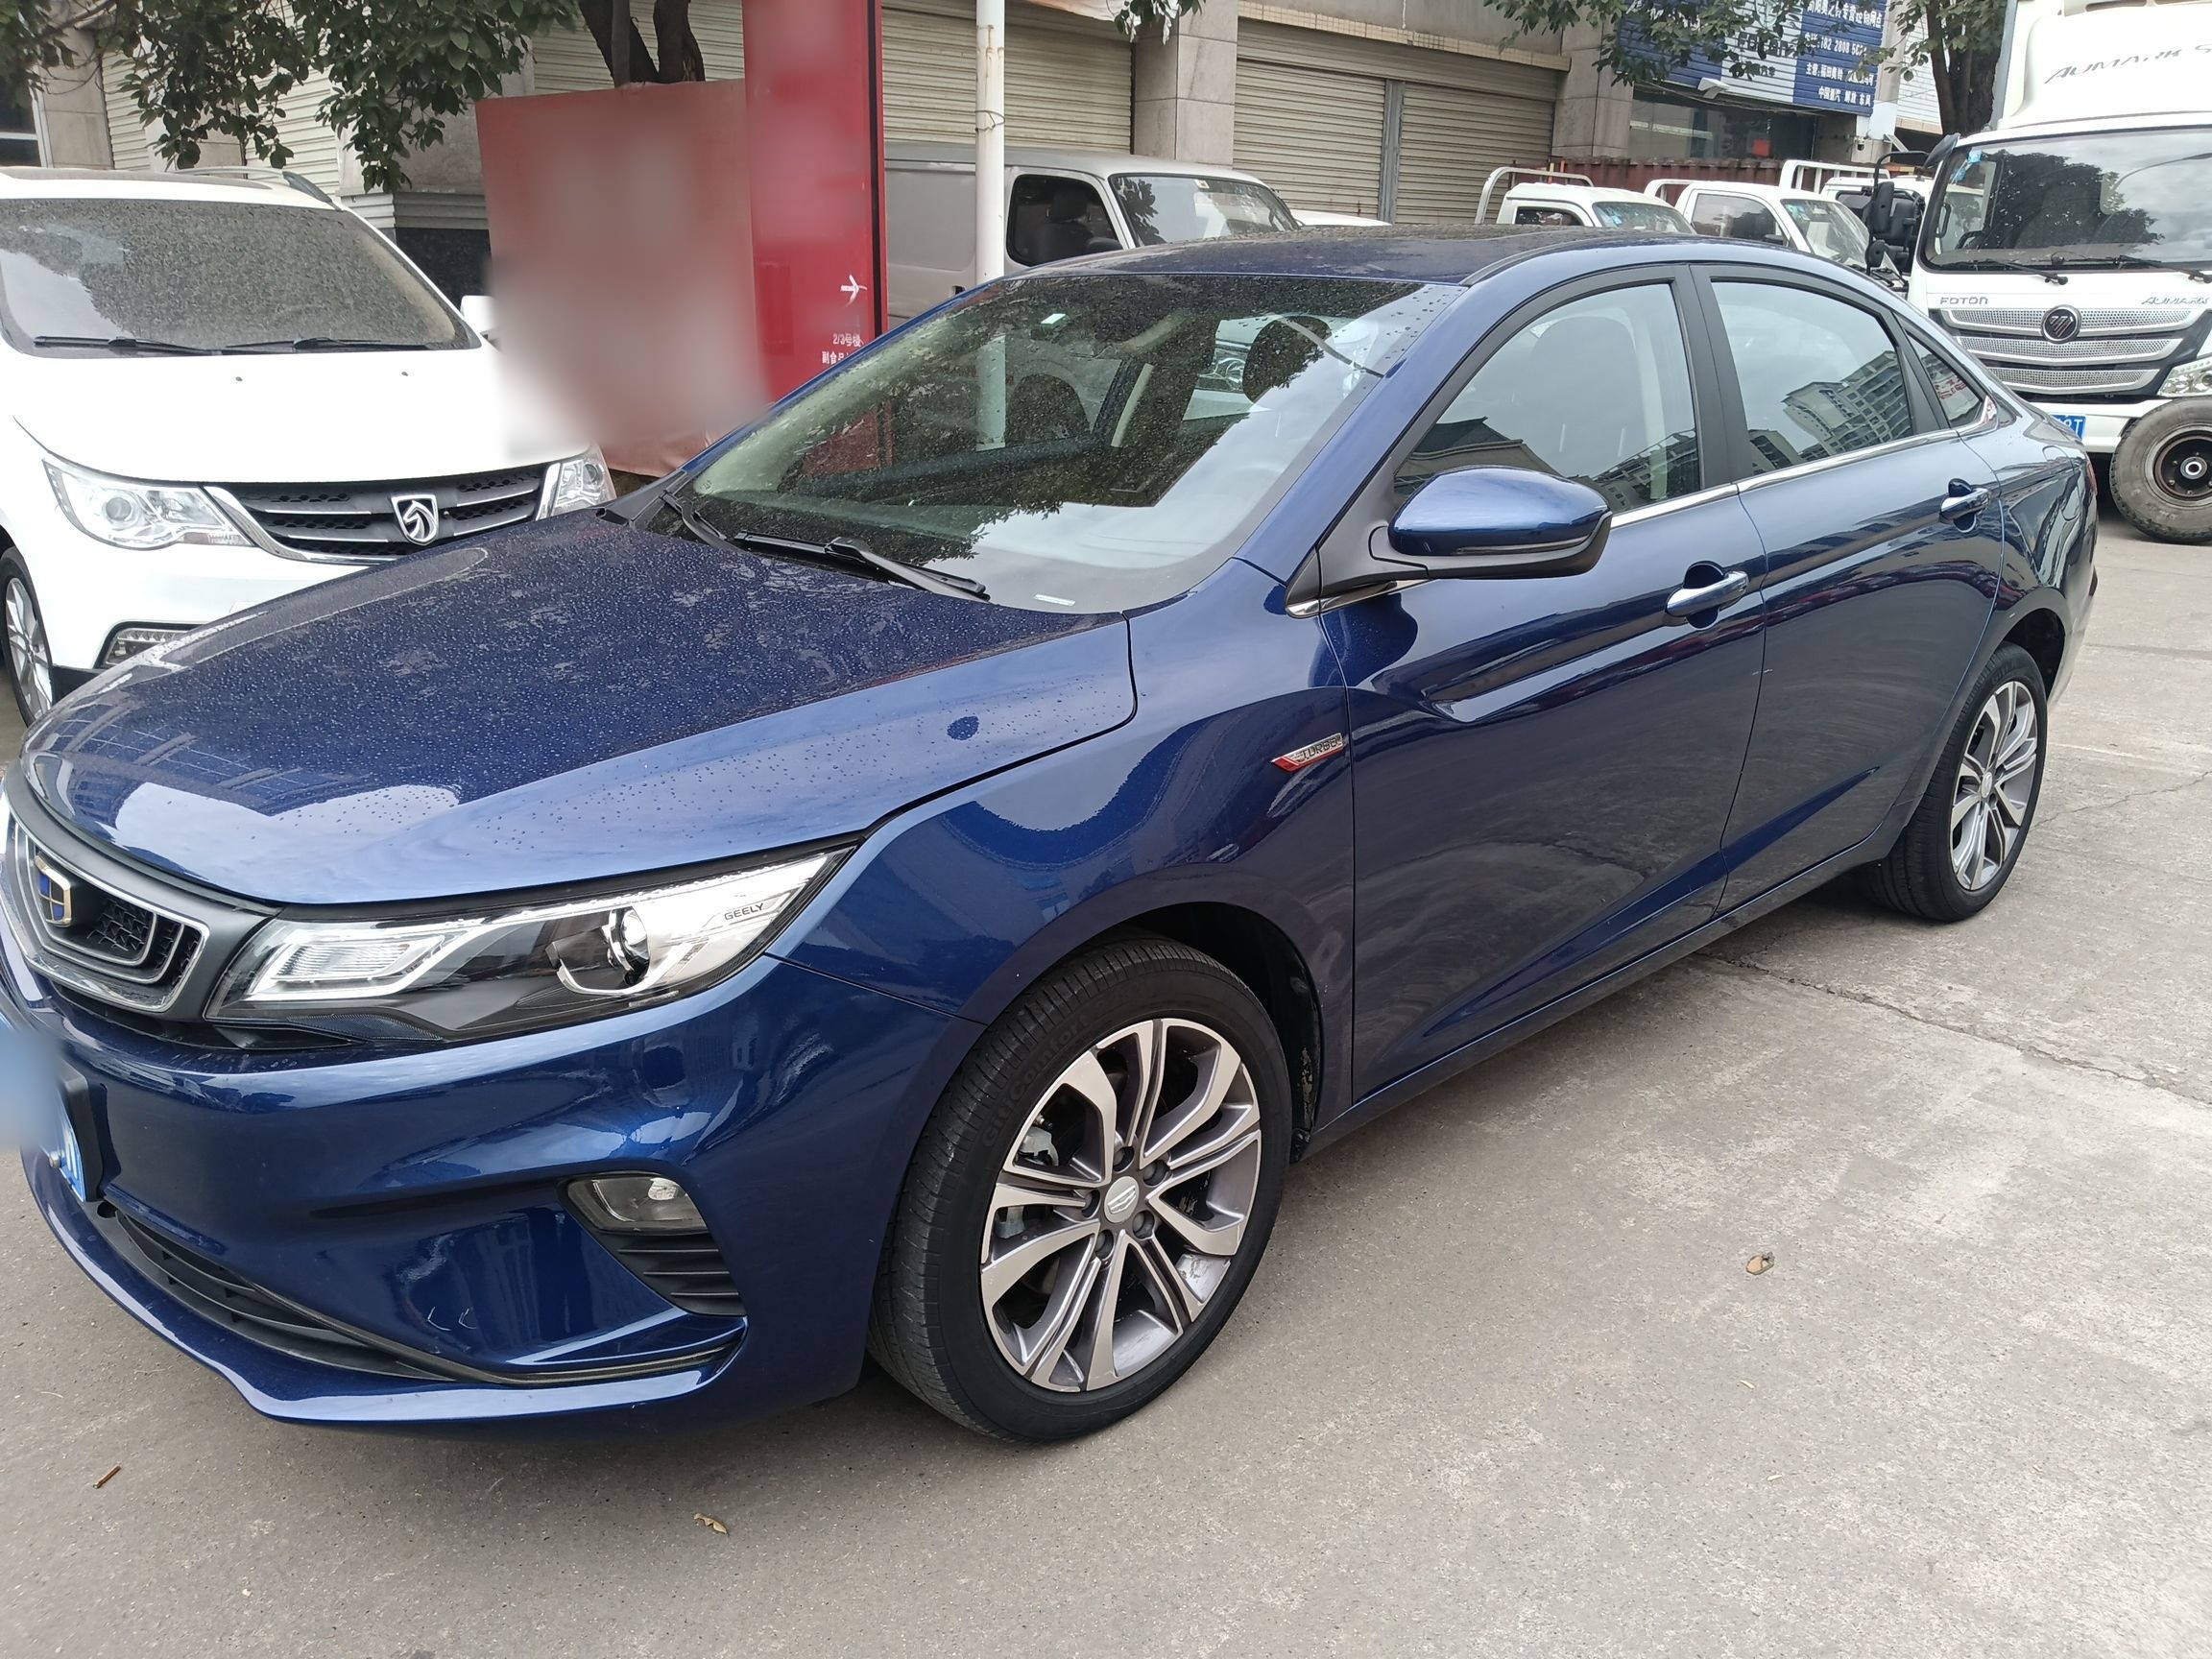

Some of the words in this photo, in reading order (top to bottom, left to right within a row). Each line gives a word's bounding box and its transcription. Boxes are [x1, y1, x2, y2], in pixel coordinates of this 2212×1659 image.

[821, 350, 849, 365] 副食品
[724, 902, 764, 921] GEELY
